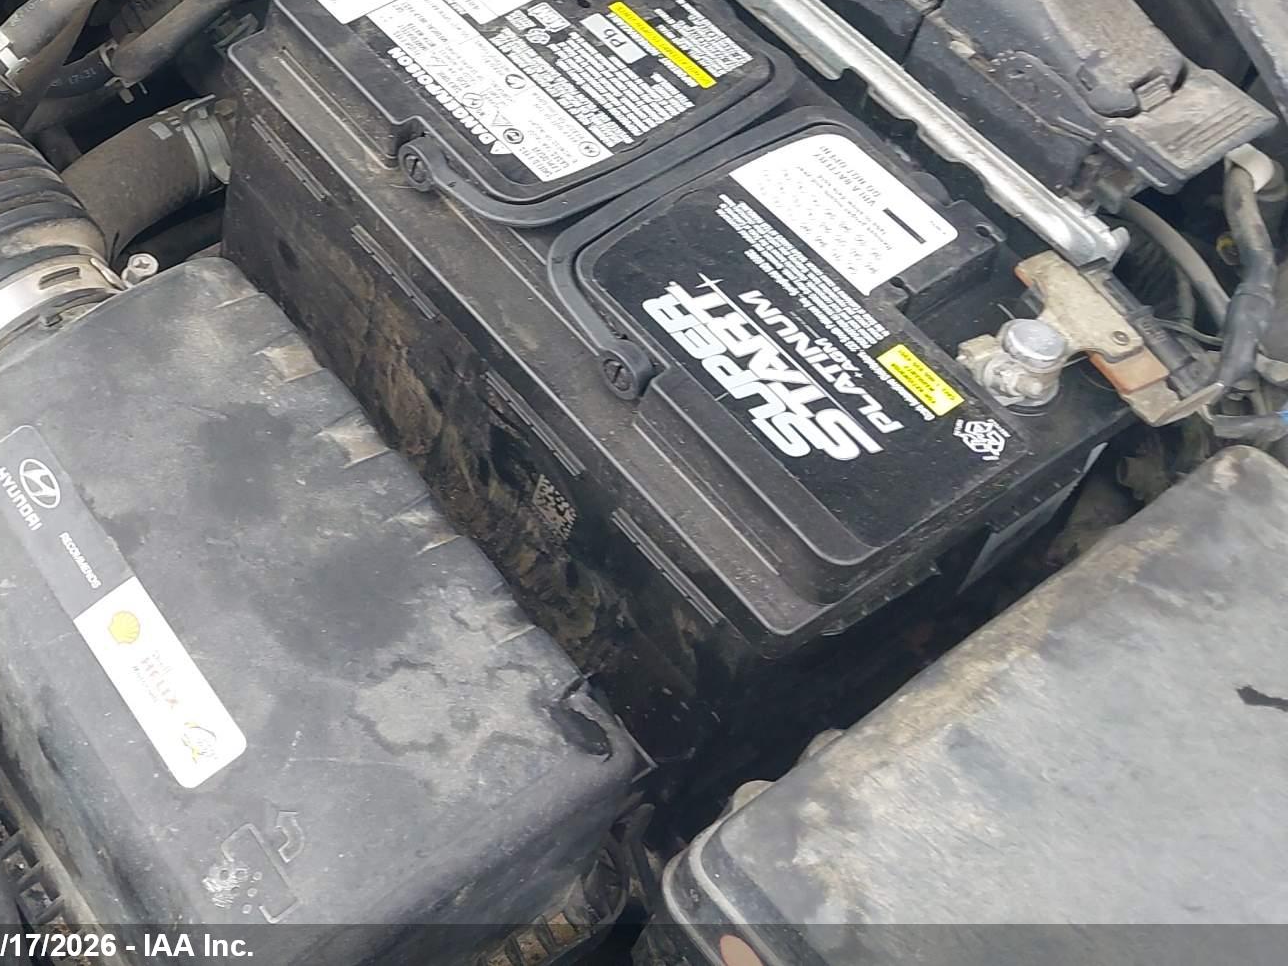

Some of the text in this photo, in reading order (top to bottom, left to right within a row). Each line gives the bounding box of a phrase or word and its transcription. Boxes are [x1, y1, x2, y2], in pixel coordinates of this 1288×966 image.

[599, 26, 627, 48] Pb
[386, 45, 497, 145] DANGER/POISON
[643, 293, 811, 458] SUPER
[664, 283, 883, 461] START
[738, 290, 904, 434] PLATINUM
[815, 336, 860, 372] AGM
[60, 532, 102, 589] RECOMMENDS
